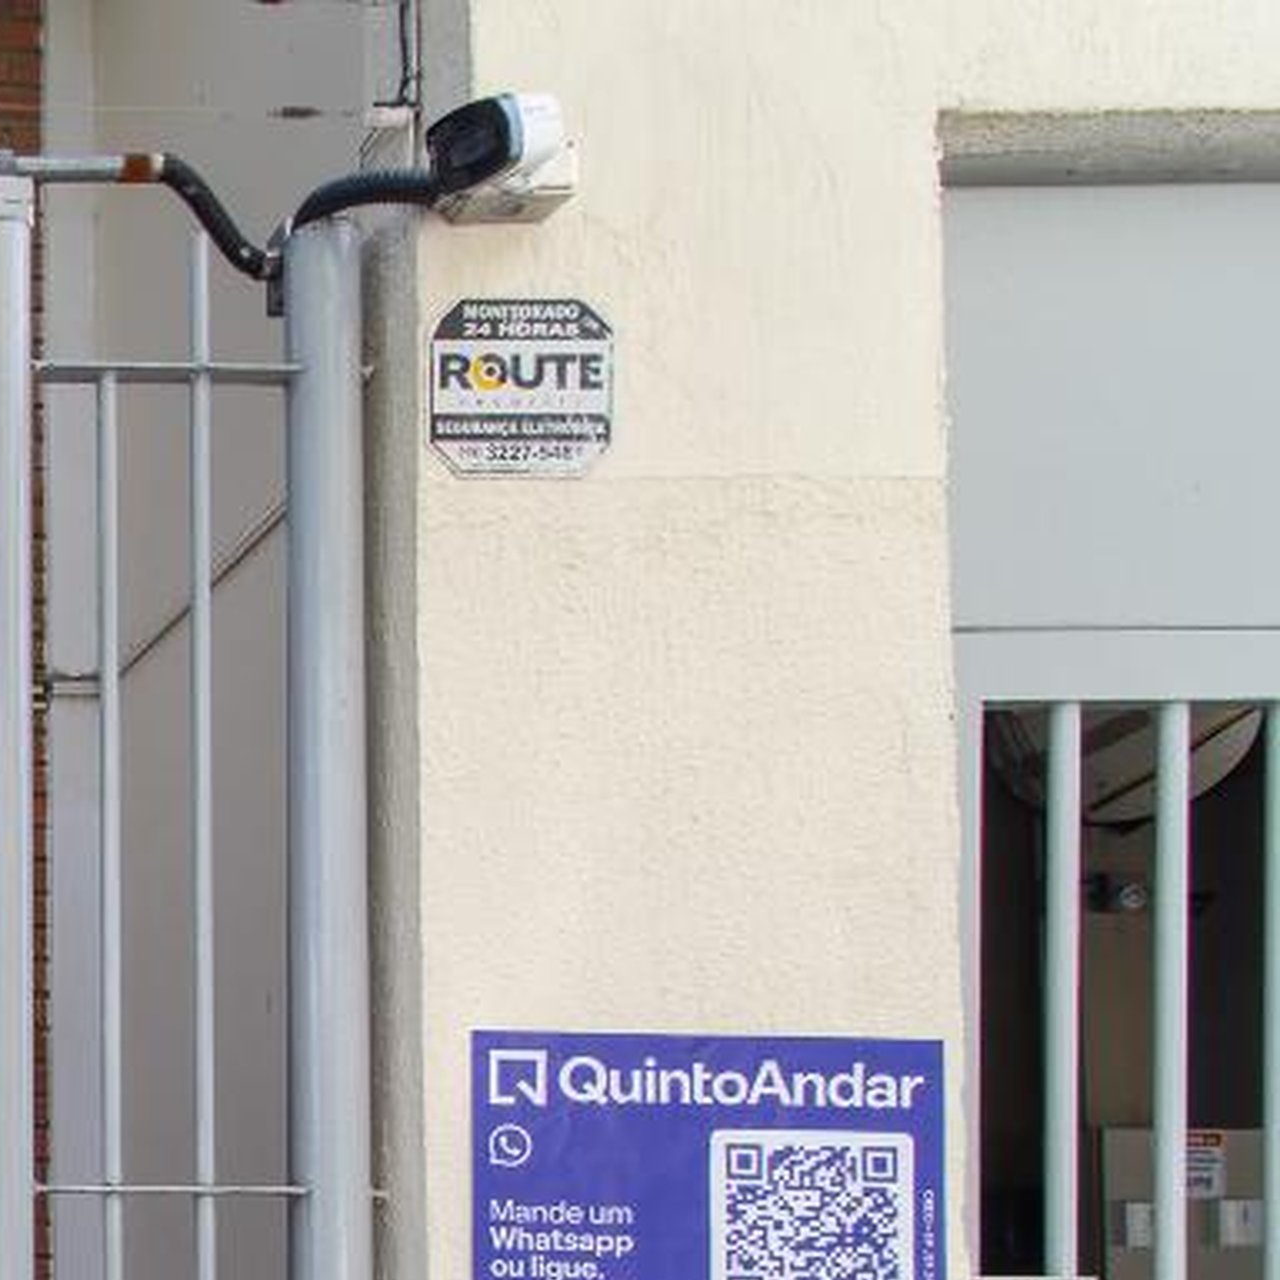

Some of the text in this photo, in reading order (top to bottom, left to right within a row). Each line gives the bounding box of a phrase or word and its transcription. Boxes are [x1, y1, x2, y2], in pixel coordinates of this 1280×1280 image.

[462, 304, 580, 321] MONITORADO
[463, 322, 580, 337] 24 HORAS
[439, 352, 604, 390] ROUTE
[557, 1054, 925, 1109] QuintoAndar
[490, 1199, 635, 1225] Mande um
[489, 1225, 634, 1258] Whatsapp
[490, 1258, 525, 1278] ou
